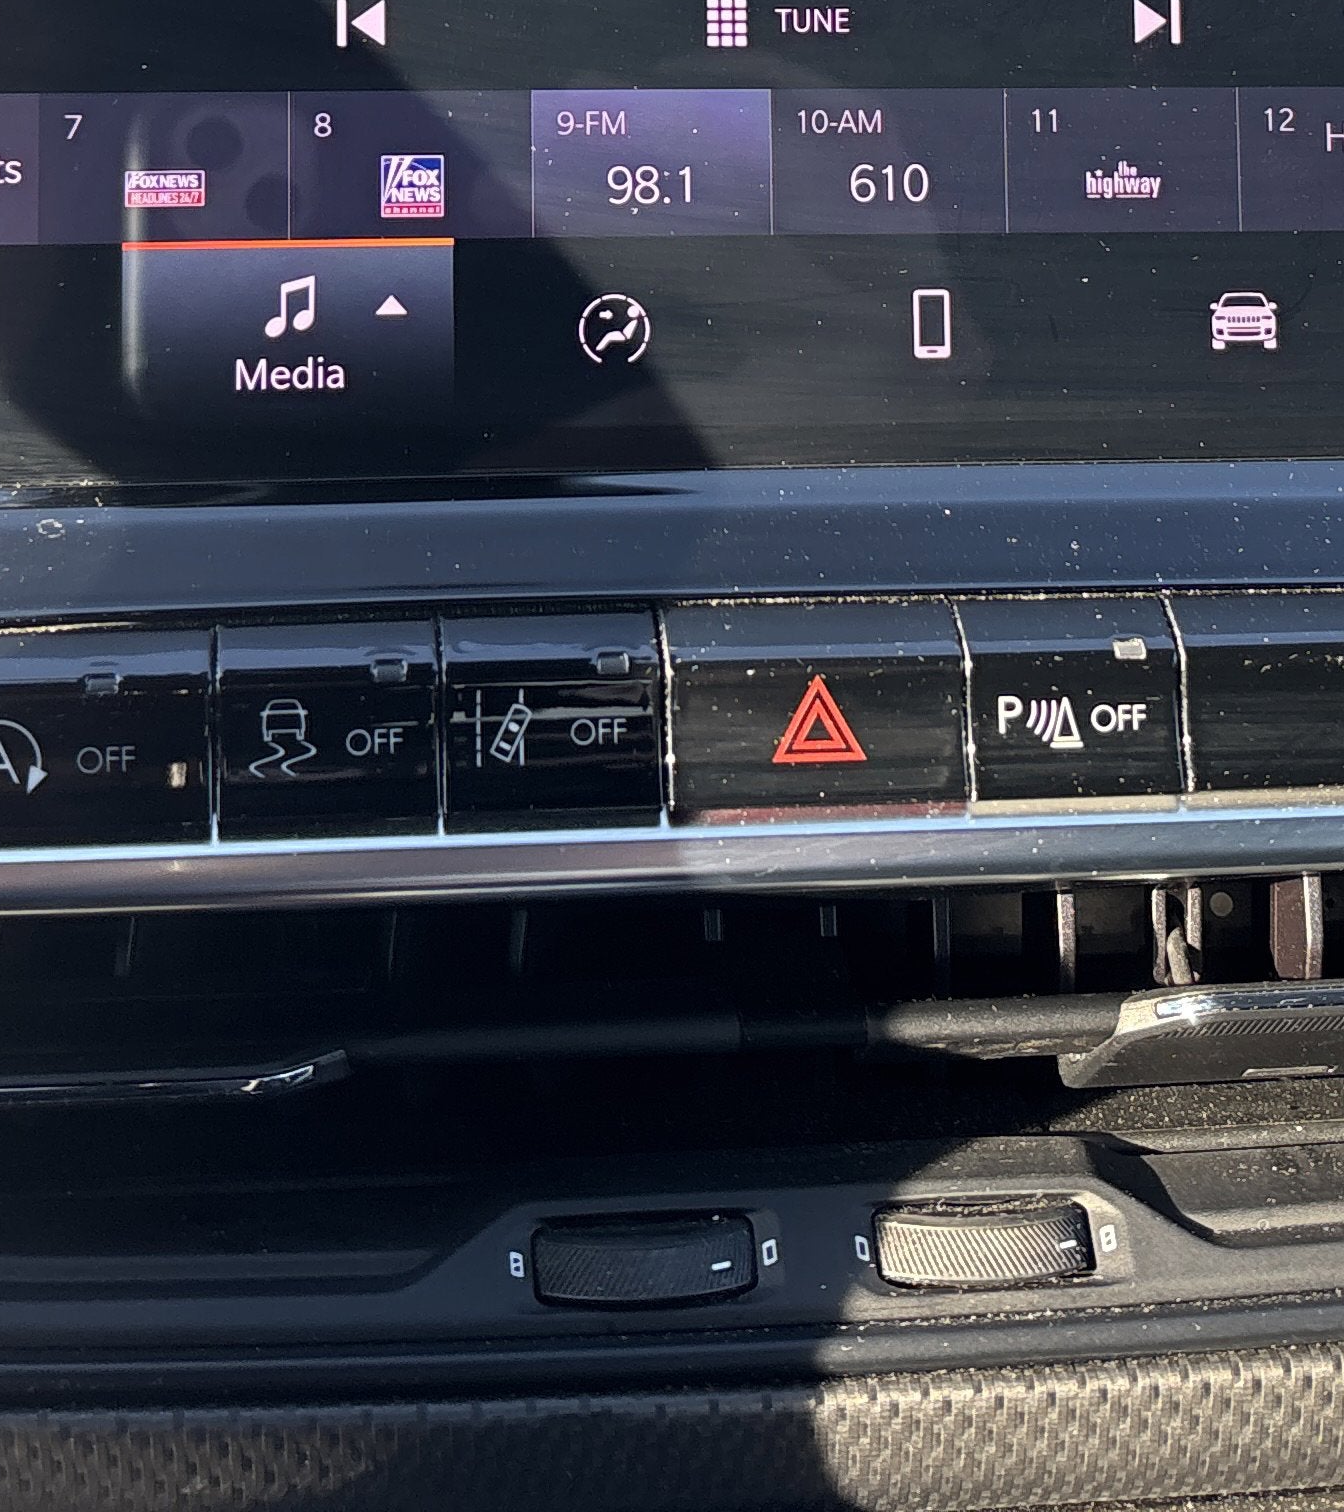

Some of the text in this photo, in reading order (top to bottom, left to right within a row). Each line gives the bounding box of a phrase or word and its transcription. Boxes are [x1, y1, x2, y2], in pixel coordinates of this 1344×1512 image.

[774, 8, 850, 33] TUNE
[64, 114, 83, 140] 7
[313, 112, 332, 138] 8
[557, 110, 626, 136] 9-FM
[797, 109, 882, 134] 10-AM
[1031, 108, 1058, 133] 11
[1264, 107, 1295, 132] 12
[133, 173, 199, 188] FOX NEWS
[401, 169, 440, 186] FOX
[1117, 160, 1138, 177] the
[390, 186, 441, 203] NEWS
[607, 165, 691, 205] 98.1
[850, 163, 929, 203] 610
[1085, 169, 1162, 199] highway
[130, 192, 178, 205] HEADLINES
[235, 356, 345, 391] Media
[1090, 703, 1147, 733] OFF
[345, 727, 404, 756] OFF
[568, 717, 629, 746] OFF
[76, 746, 136, 774] OFF
